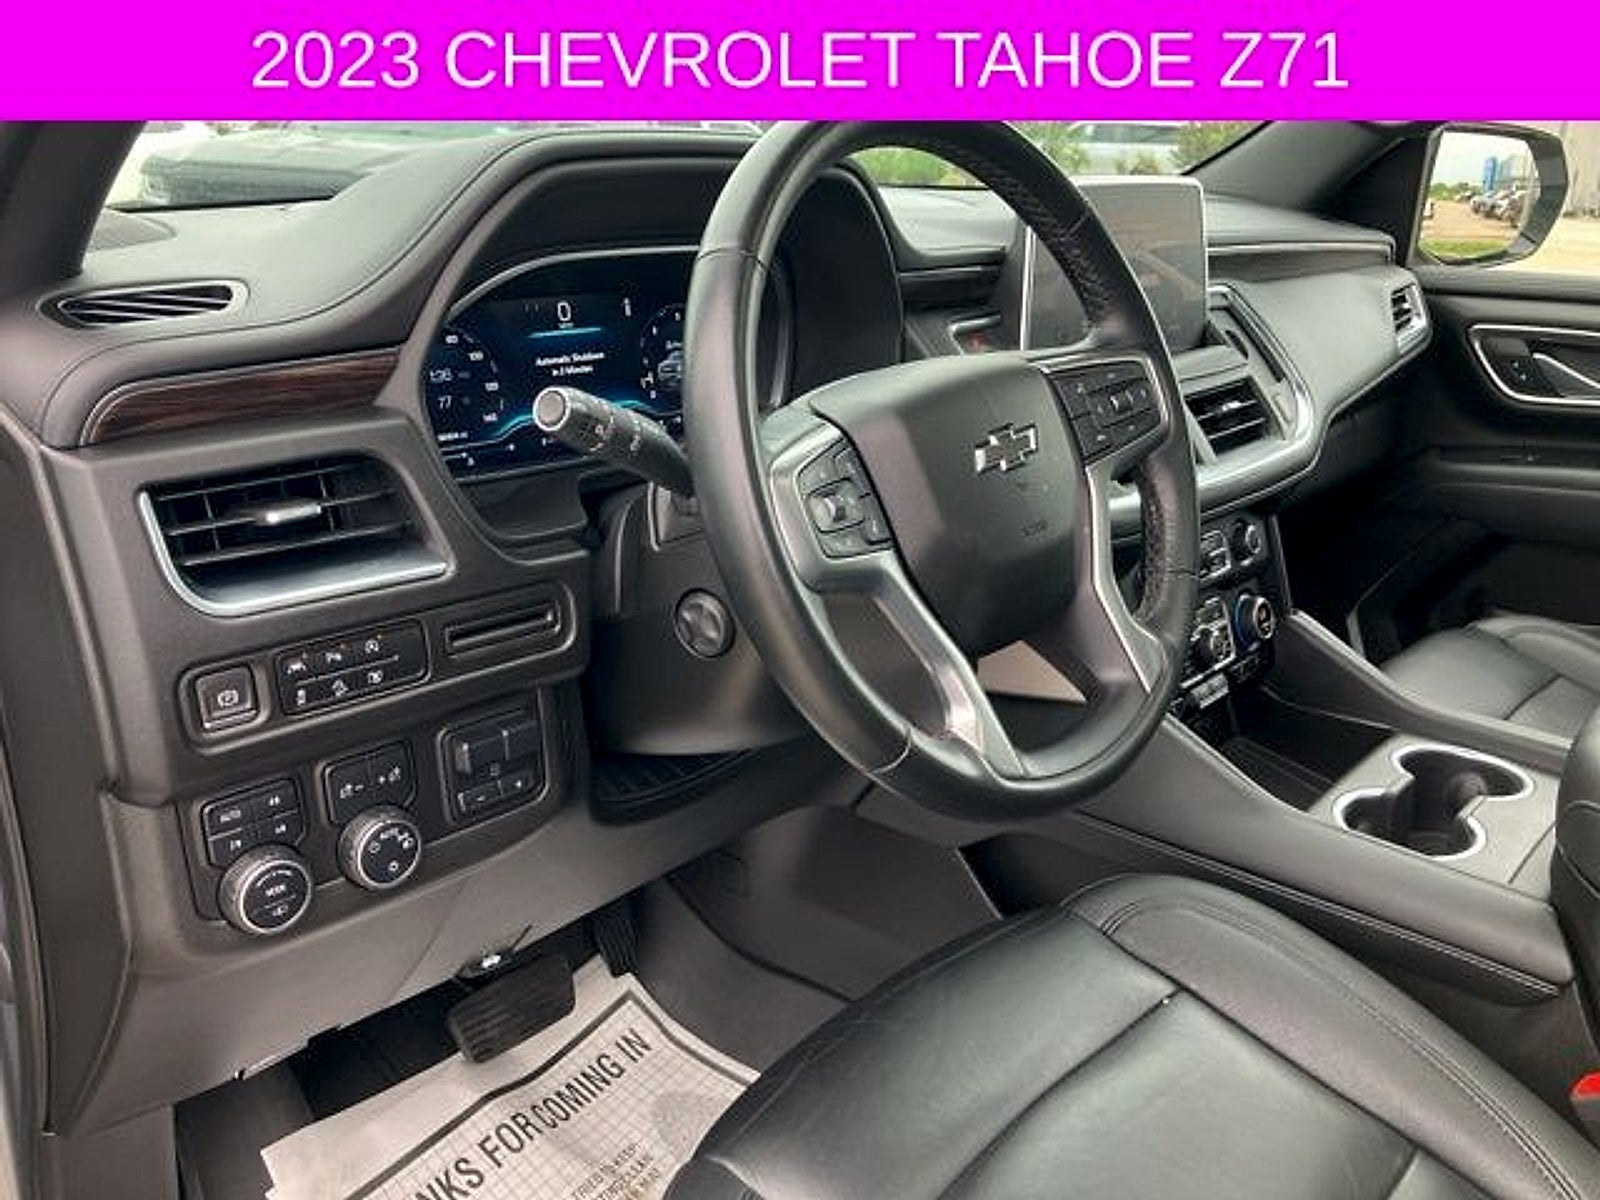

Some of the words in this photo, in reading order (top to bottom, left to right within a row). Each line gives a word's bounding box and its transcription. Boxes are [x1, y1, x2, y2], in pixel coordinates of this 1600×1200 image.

[477, 1111, 544, 1168] FOR
[530, 1052, 626, 1129] COMING
[614, 1027, 653, 1064] IN
